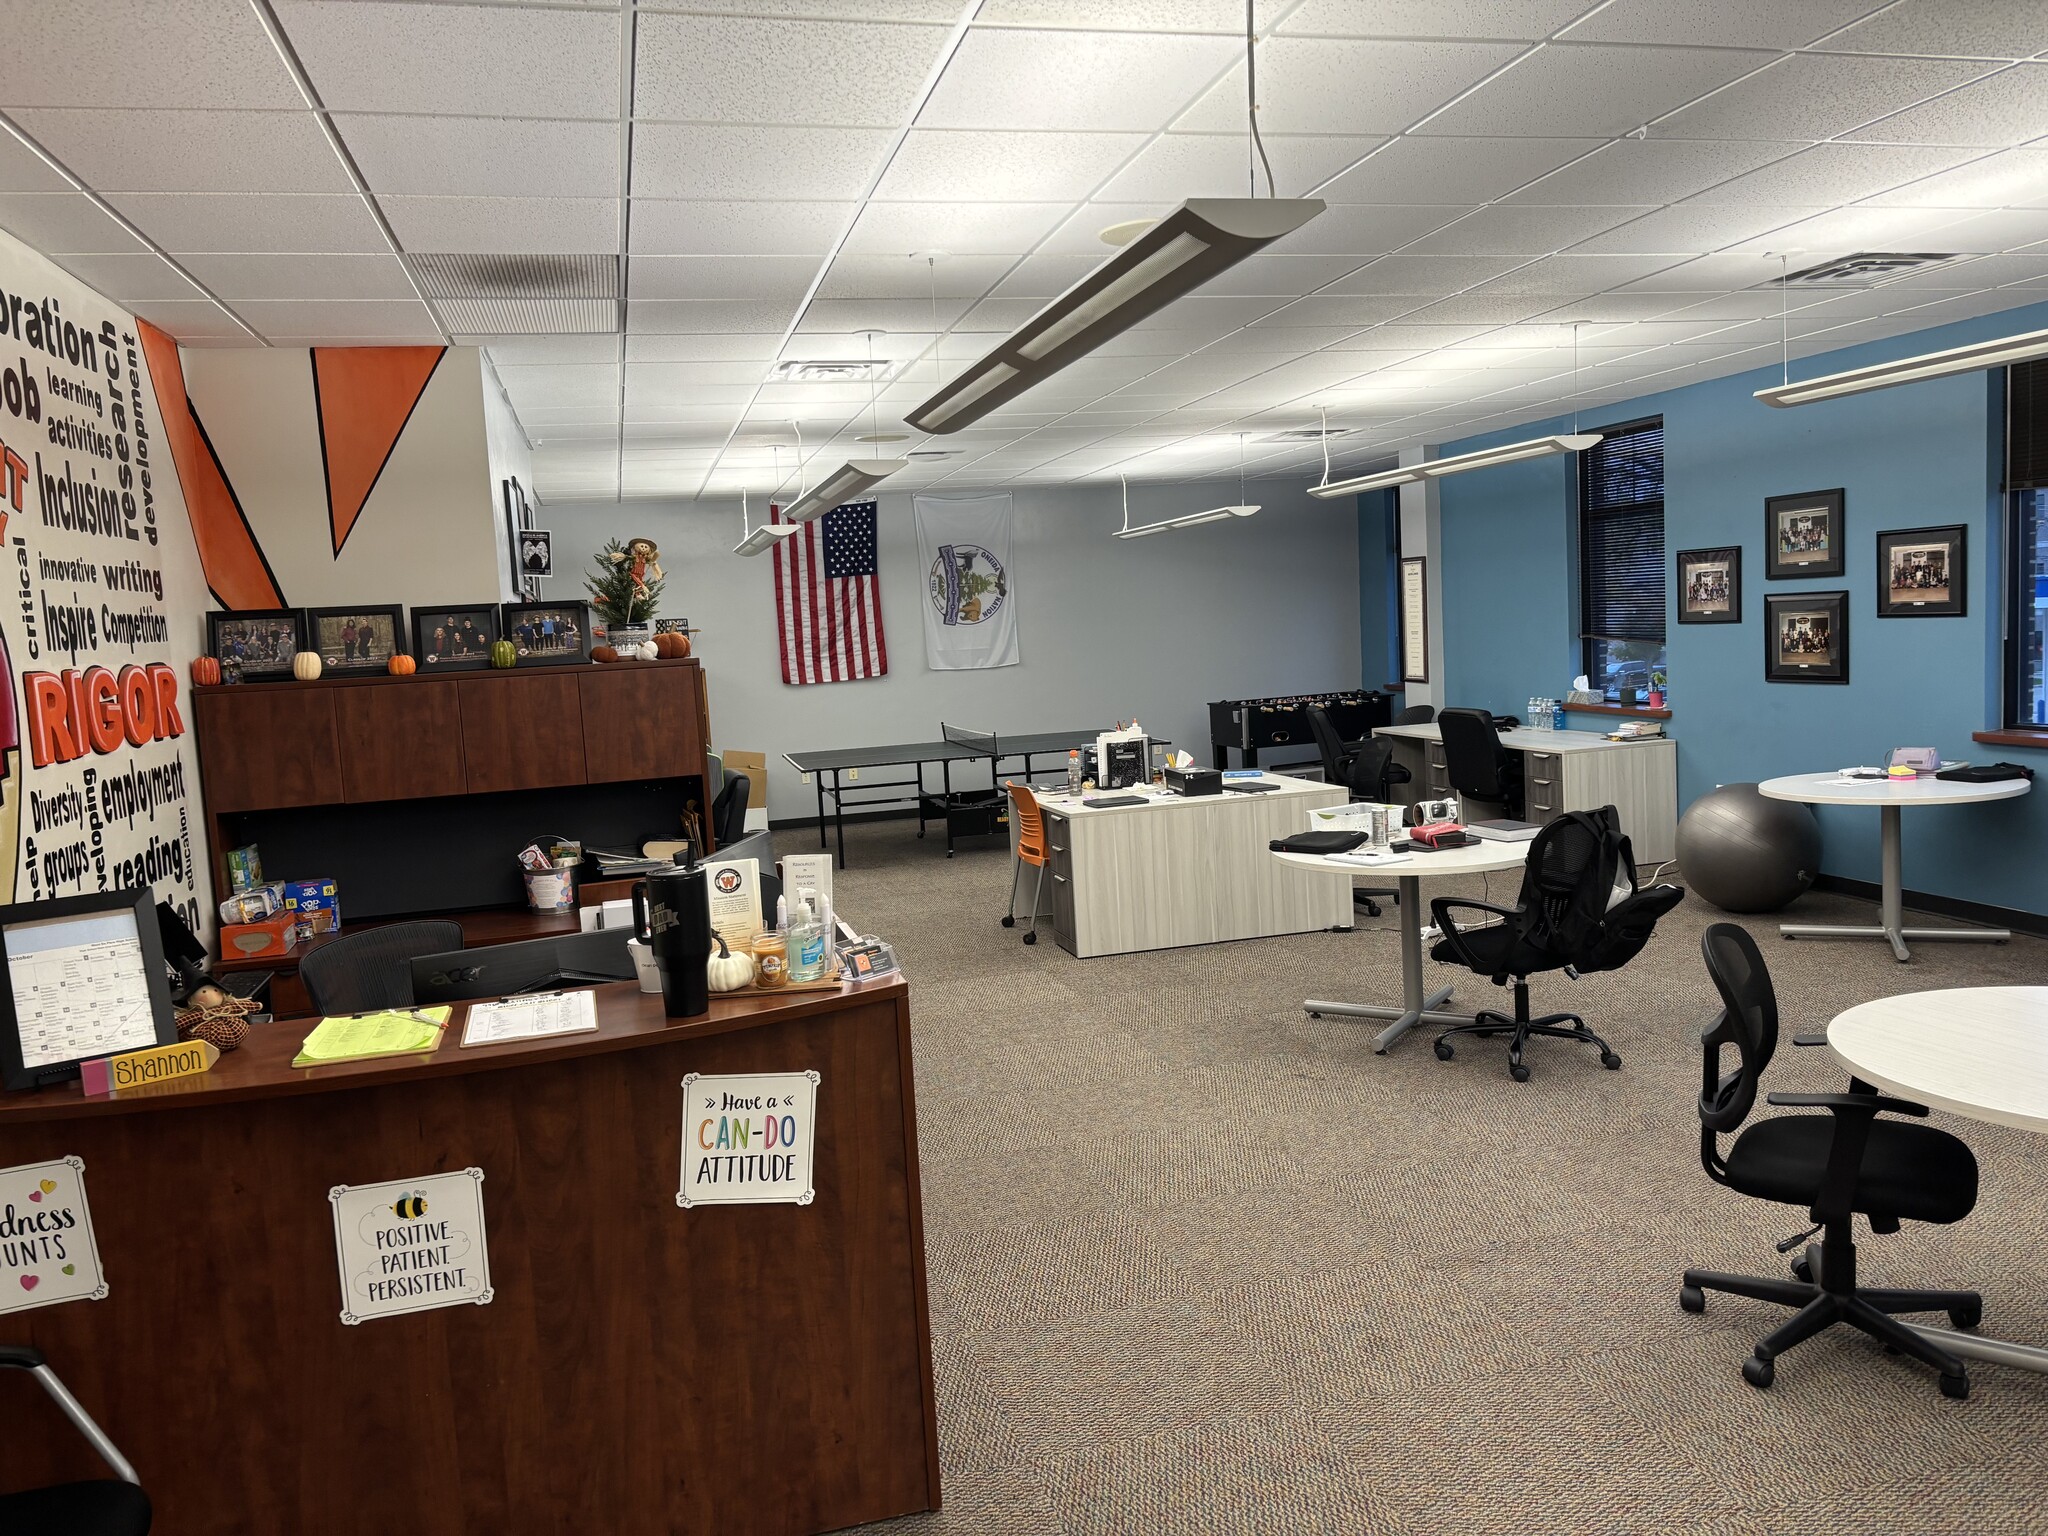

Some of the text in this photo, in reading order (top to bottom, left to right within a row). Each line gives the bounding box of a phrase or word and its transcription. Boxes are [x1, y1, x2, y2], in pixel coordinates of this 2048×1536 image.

[0, 357, 41, 424] ob
[46, 366, 103, 418] learning
[48, 414, 113, 460] activities
[98, 320, 140, 541] research
[122, 332, 158, 547] development
[35, 451, 123, 539] Inclusion
[38, 550, 97, 583] innovative
[102, 560, 164, 601] writing
[980, 551, 1001, 573] ONEIDA
[12, 536, 39, 660] critical
[982, 596, 1002, 618] NATION
[41, 589, 169, 667] Inspire Competition
[23, 662, 185, 770] RIGOR
[30, 782, 84, 834] Diversity
[100, 749, 186, 831] employment
[113, 834, 184, 892] reading
[178, 806, 195, 892] education
[43, 840, 90, 899] groups
[720, 875, 736, 889] W
[652, 911, 669, 927] DAD
[7, 954, 33, 963] October
[429, 965, 487, 986] acer
[115, 1049, 202, 1084] Shannon
[721, 1092, 778, 1111] Have a
[698, 1115, 796, 1150] CAN-DO
[696, 1154, 796, 1184] ATTITUDE
[0, 1204, 76, 1238] dness
[376, 1220, 454, 1250] POSITIVE.
[381, 1245, 450, 1275] PATIENT.
[368, 1267, 466, 1302] PERSISTENT.
